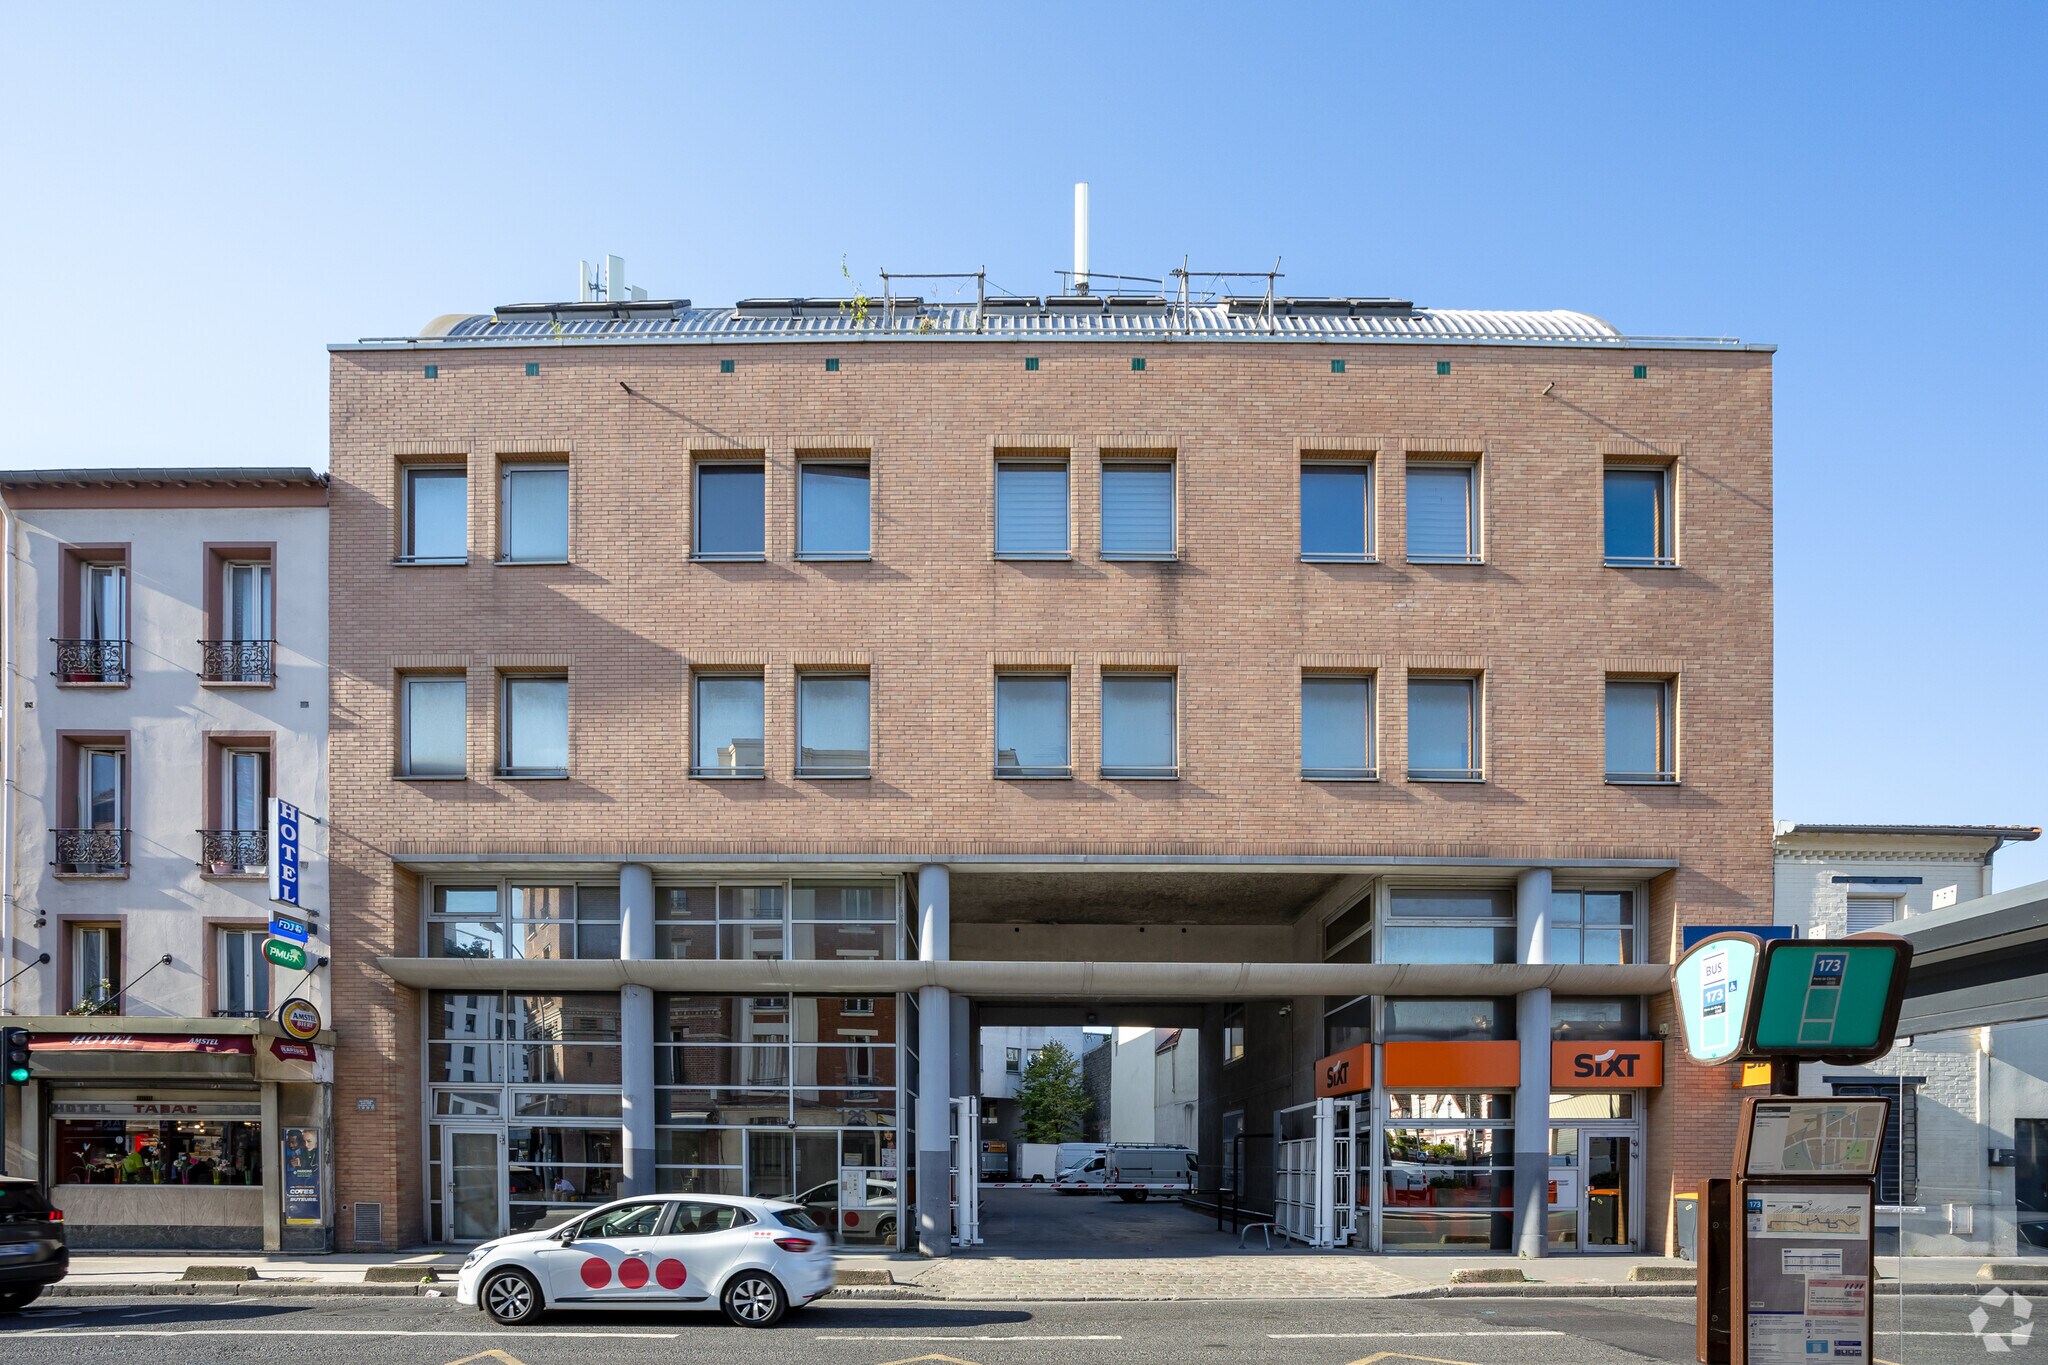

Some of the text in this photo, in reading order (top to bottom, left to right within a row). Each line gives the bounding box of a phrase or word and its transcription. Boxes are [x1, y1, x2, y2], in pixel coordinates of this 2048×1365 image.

[280, 801, 297, 903] HOTEL
[278, 920, 294, 932] FDJ
[270, 946, 290, 961] PMU
[1706, 963, 1722, 976] BUS
[1819, 960, 1841, 972] 173
[1705, 988, 1723, 1003] 173
[293, 1013, 317, 1022] AMSTEL
[70, 1035, 135, 1045] HOTEL
[188, 1037, 219, 1046] AMSTEL
[53, 1103, 111, 1113] HOTEL
[133, 1104, 198, 1114] TABAC
